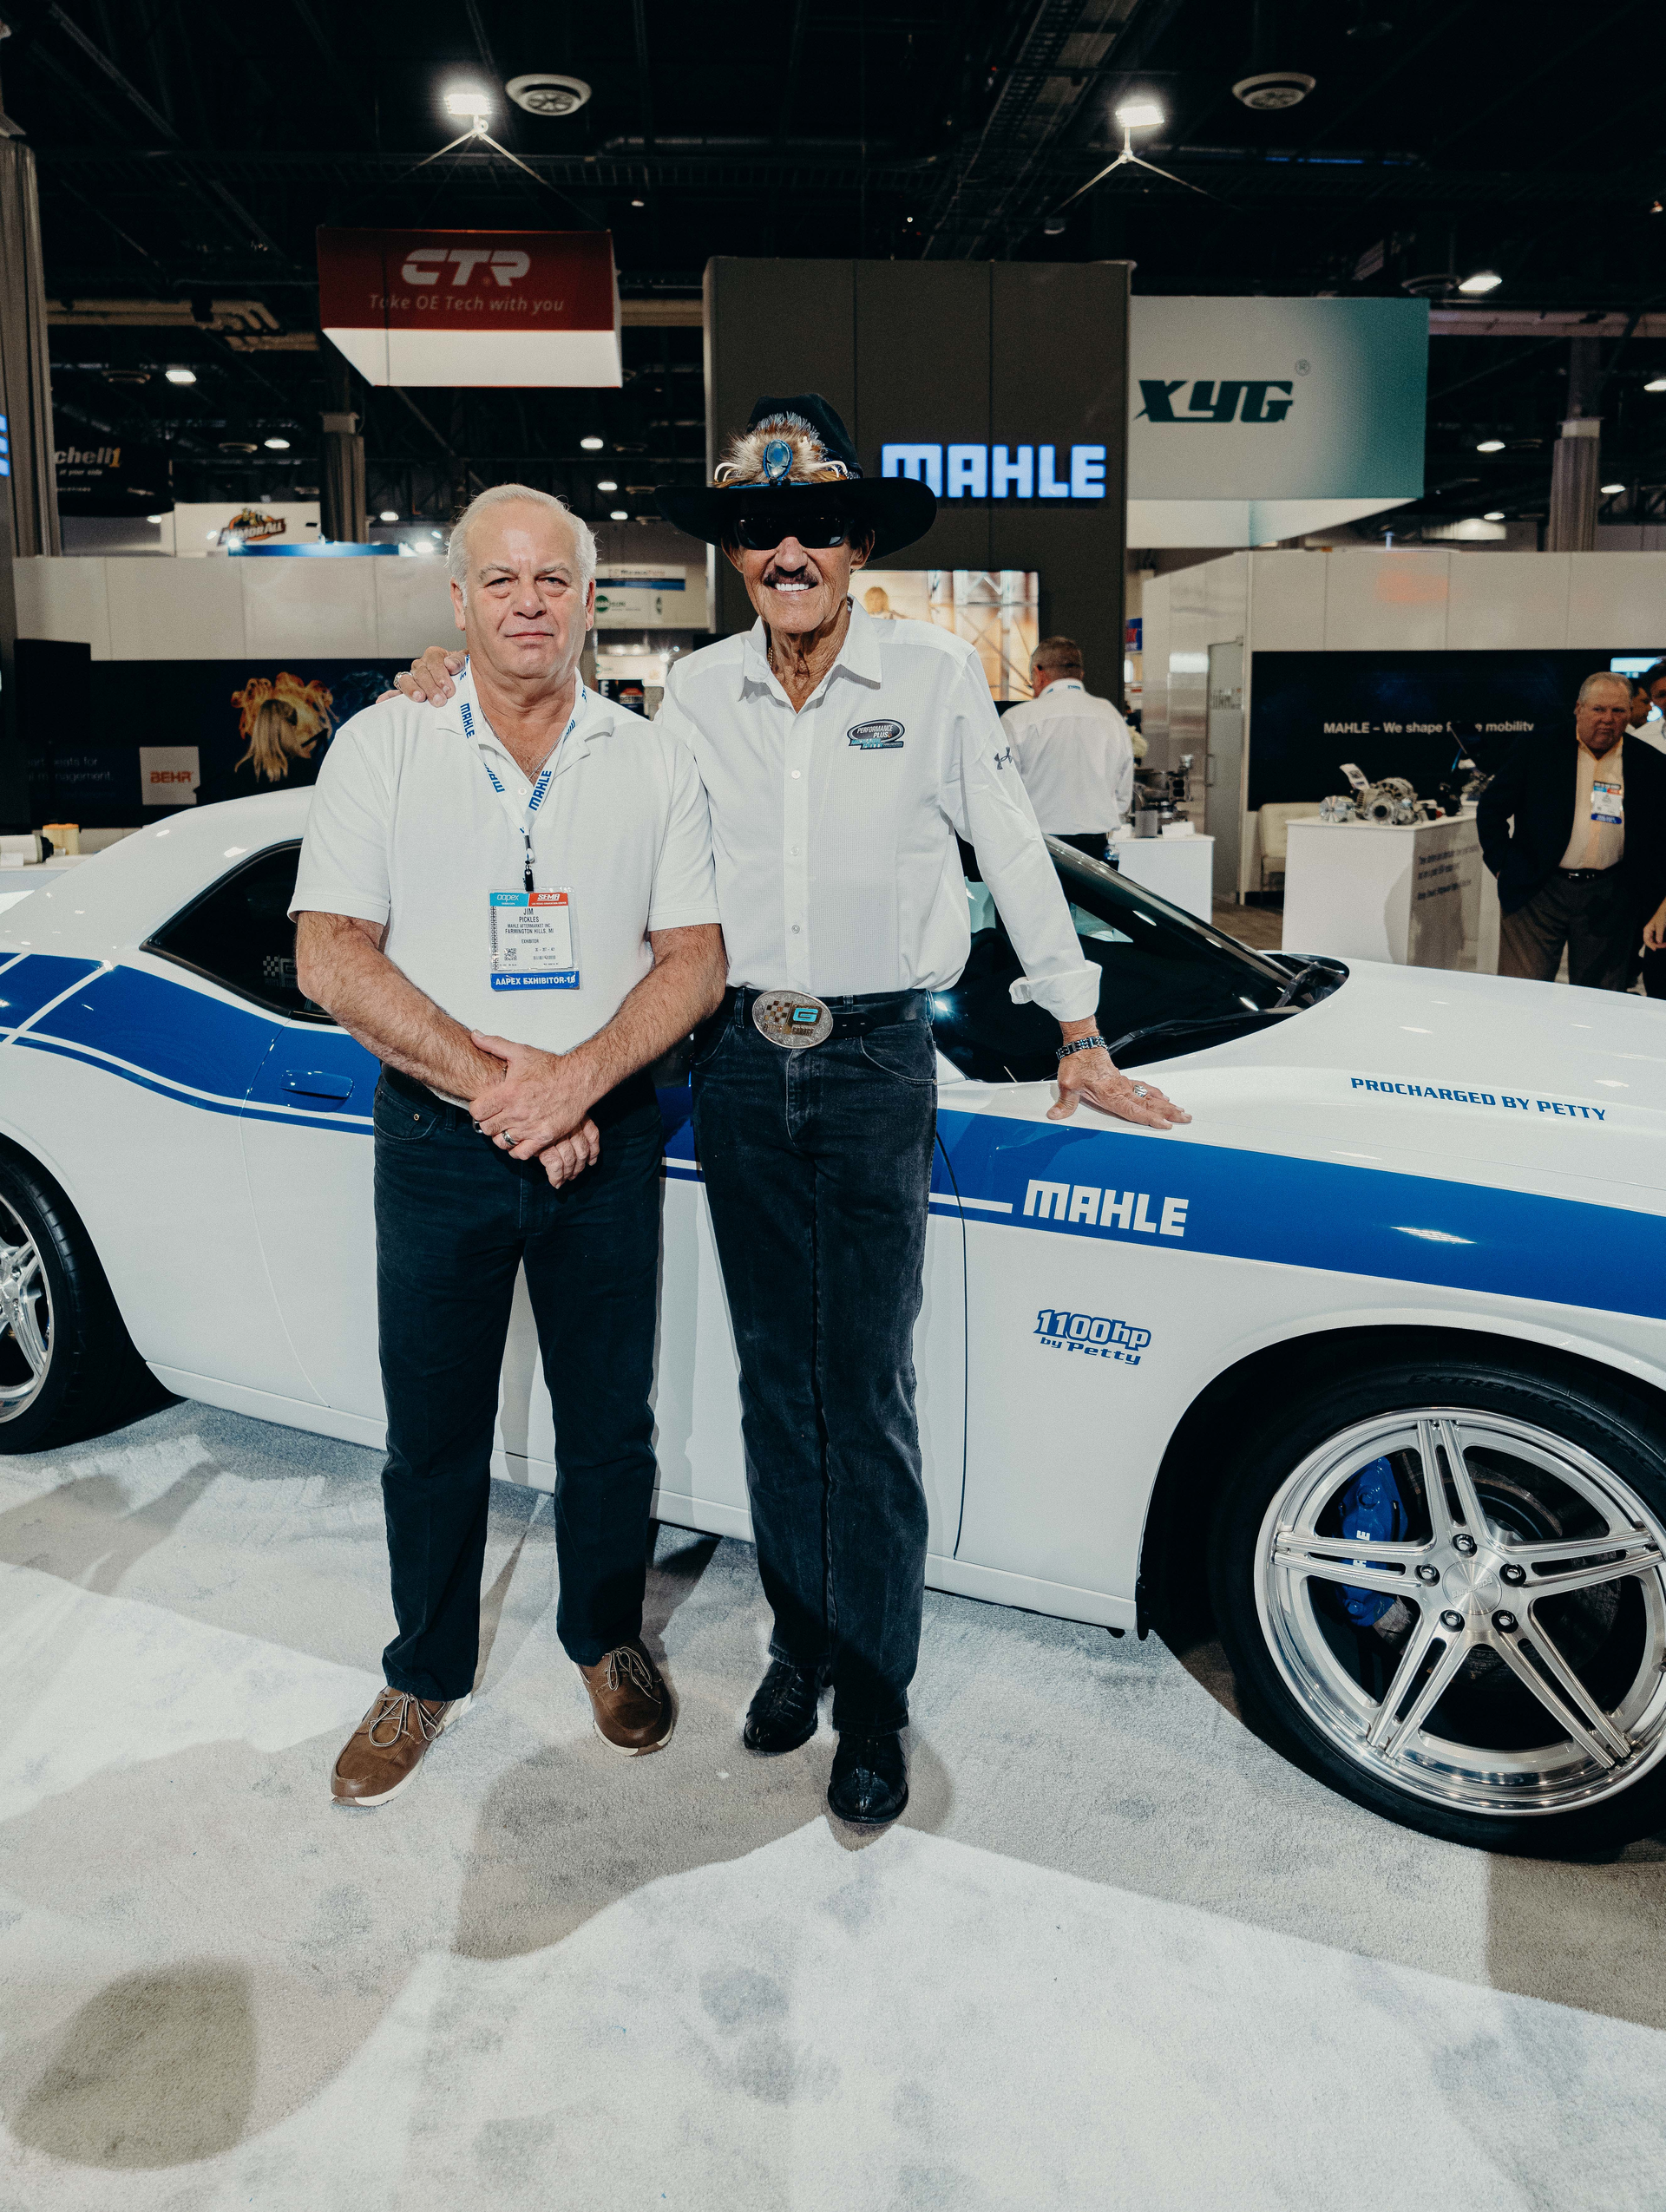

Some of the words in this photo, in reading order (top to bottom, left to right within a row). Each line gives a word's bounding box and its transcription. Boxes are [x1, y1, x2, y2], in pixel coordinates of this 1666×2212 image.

[401, 248, 531, 287] CTR
[370, 294, 409, 310] Take
[416, 295, 439, 311] OE
[445, 296, 484, 311] Tech
[489, 296, 528, 311] with
[532, 298, 565, 315] you
[1134, 379, 1294, 423] XYG
[882, 443, 1106, 498] MAHLE
[460, 703, 476, 739] MAHLE
[856, 724, 894, 734] PERFORMANCE
[1323, 722, 1370, 734] MAHLE
[1383, 722, 1403, 734] We
[1406, 722, 1443, 736] shape
[150, 771, 193, 784] BEHR
[528, 770, 552, 811] MAHLE
[496, 893, 520, 902] aapex
[495, 977, 521, 985] AAPEX
[1350, 1077, 1496, 1105] PROCHARGED
[1500, 1095, 1530, 1110] BY
[1536, 1100, 1606, 1122] PETTY
[1023, 1179, 1189, 1237] MAHLE
[1033, 1308, 1151, 1351] 1100hp
[1040, 1337, 1063, 1349] by
[1066, 1340, 1142, 1365] Petty
